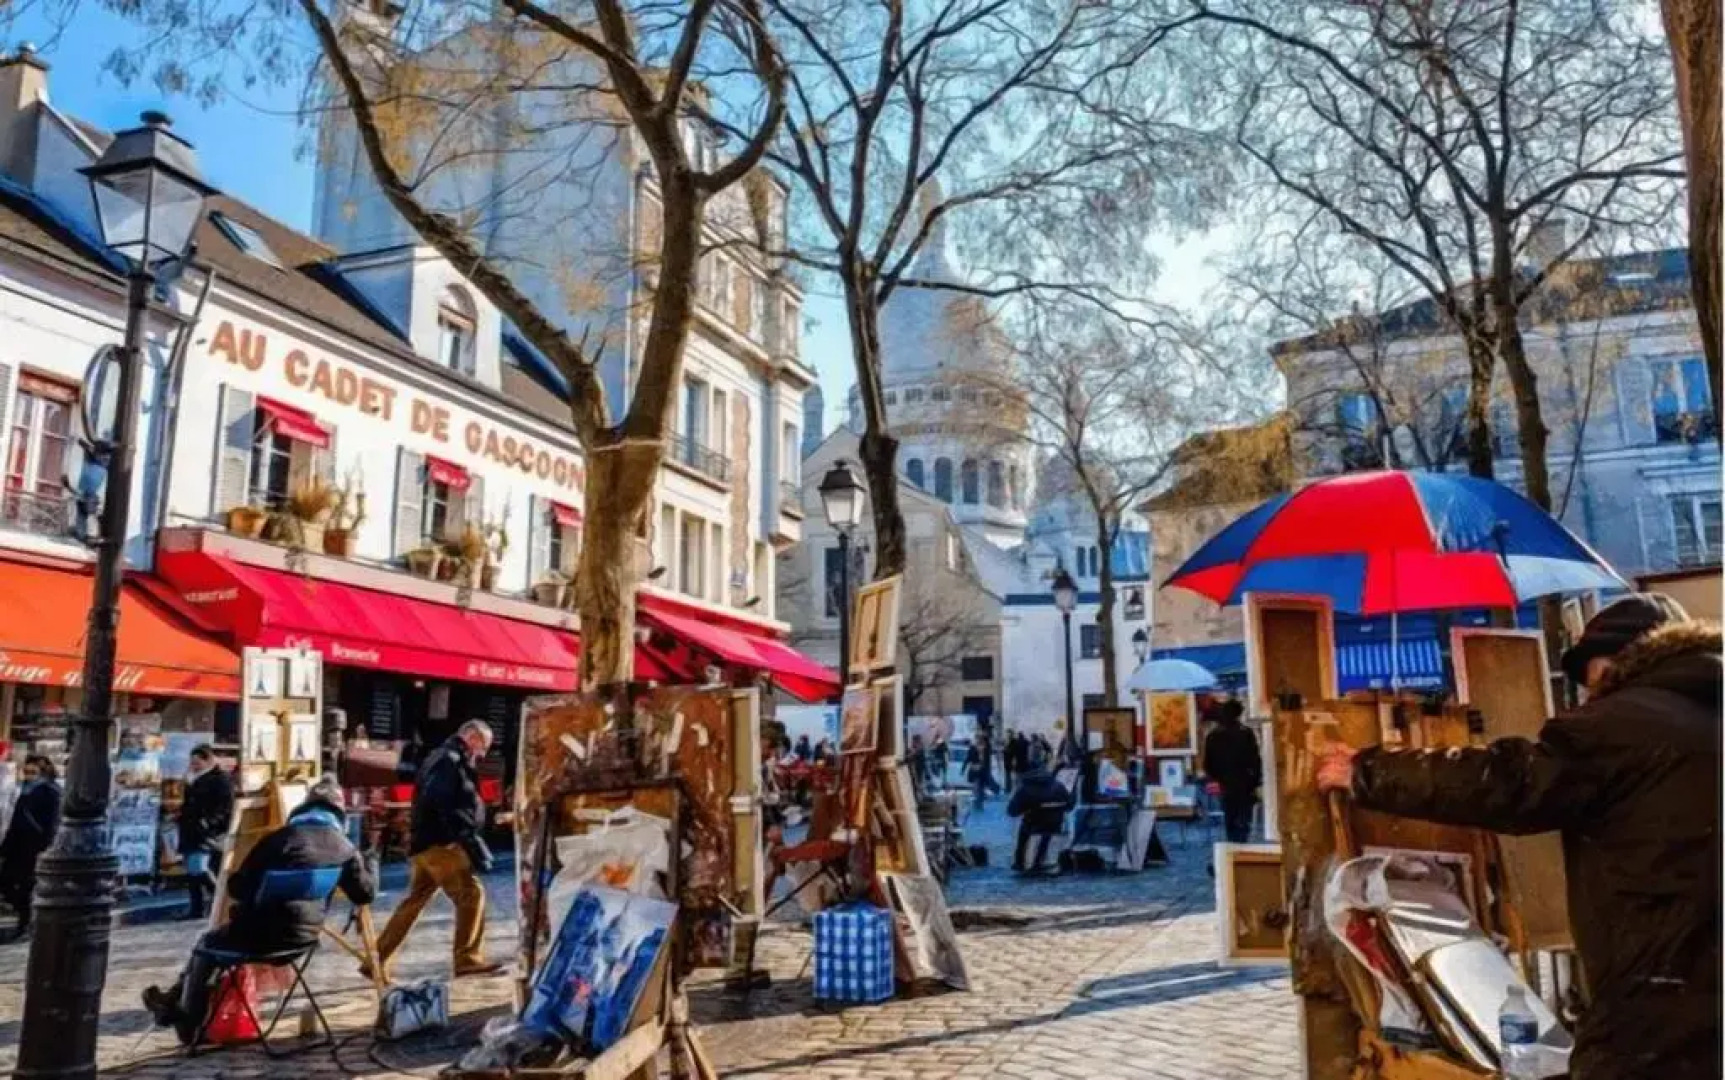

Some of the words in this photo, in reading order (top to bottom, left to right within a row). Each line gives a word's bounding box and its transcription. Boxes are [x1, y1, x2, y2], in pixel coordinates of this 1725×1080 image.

[208, 320, 267, 371] AU
[284, 349, 398, 421] CADET
[410, 398, 451, 443] DE
